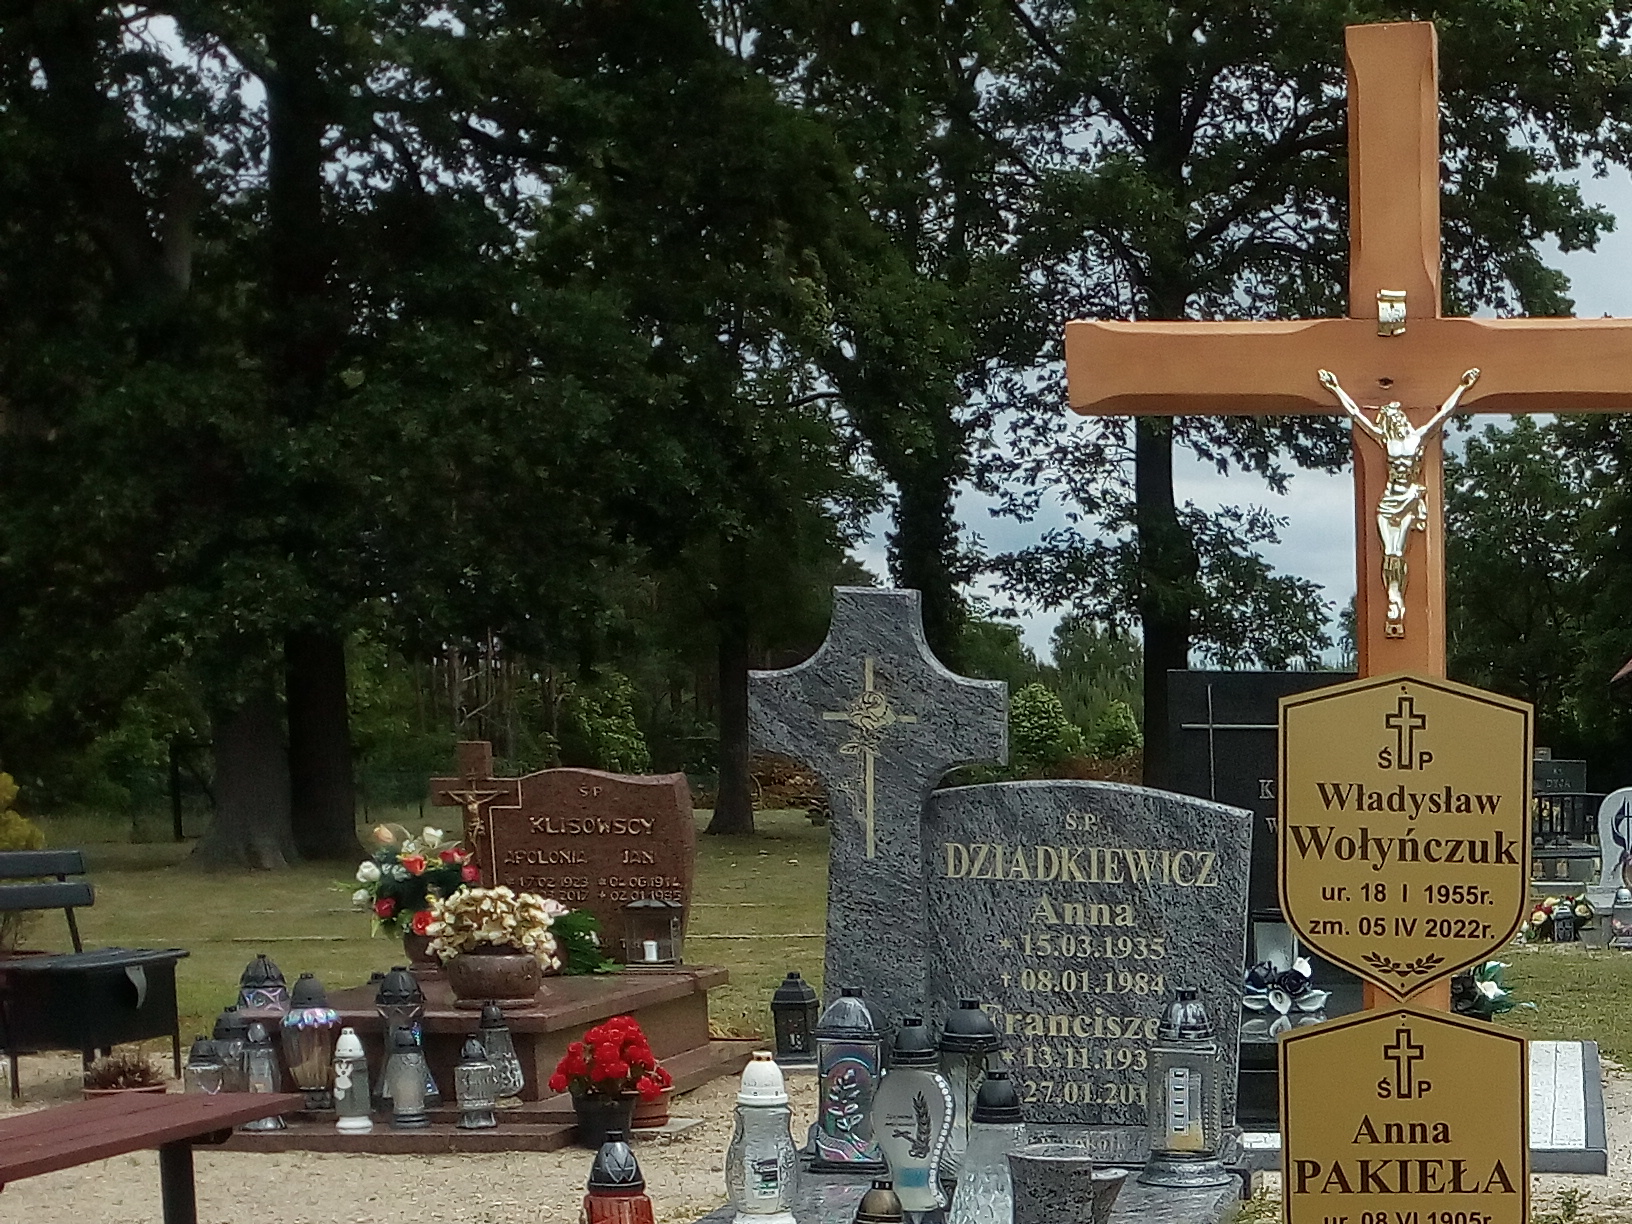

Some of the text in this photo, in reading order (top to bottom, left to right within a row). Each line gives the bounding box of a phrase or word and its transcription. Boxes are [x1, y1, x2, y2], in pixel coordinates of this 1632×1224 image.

[1315, 782, 1503, 819] Władysław
[529, 816, 656, 836] KLISOWSCY
[504, 849, 656, 865] APOLONIA JAN
[1288, 825, 1520, 872] Wołyńczuk
[944, 842, 1218, 887] DZIADKIEWICZ
[1321, 886, 1351, 902] ur.
[1360, 882, 1387, 903] 18
[1424, 885, 1494, 906] 1955r.
[1029, 897, 1136, 927] Anna
[1309, 917, 1496, 939] zm. 05 IV 2022r.
[1021, 934, 1166, 961] 15.03.1935
[1020, 969, 1166, 996] 08.01.1984
[1350, 1114, 1453, 1145] Anna
[1292, 1158, 1517, 1196] PAKIEŁA
